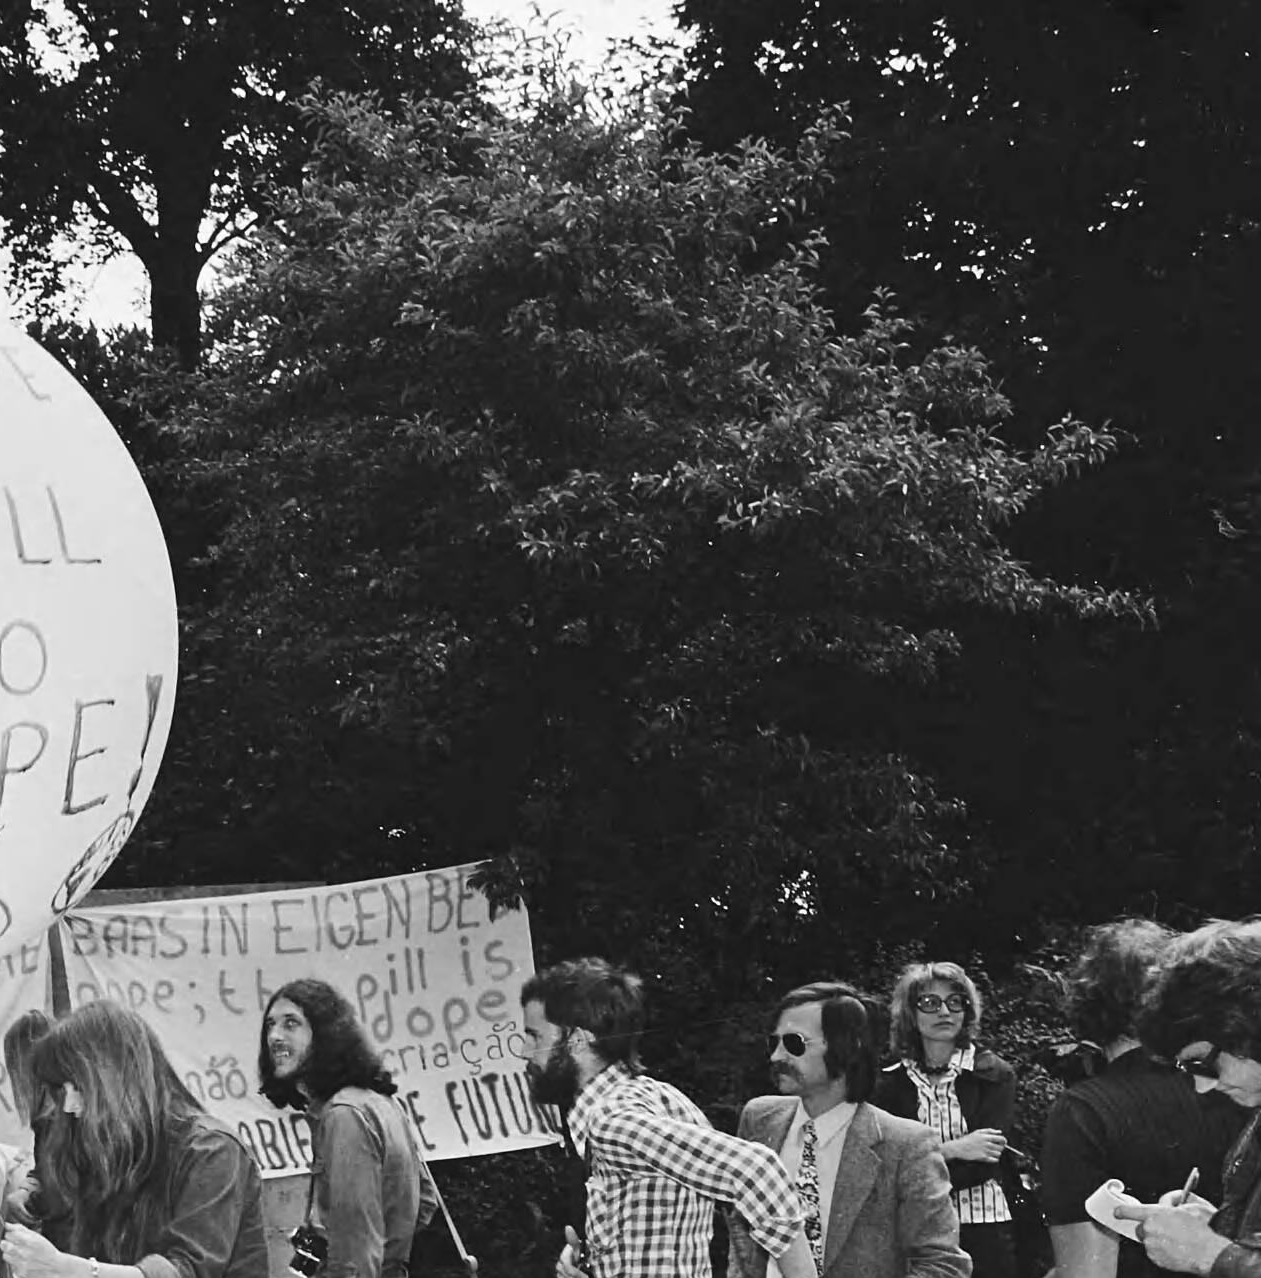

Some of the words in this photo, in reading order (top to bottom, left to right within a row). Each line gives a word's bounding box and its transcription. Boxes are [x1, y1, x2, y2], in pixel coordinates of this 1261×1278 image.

[66, 914, 189, 959] BAAS
[200, 901, 249, 957] IN
[272, 878, 411, 955] EIGEN
[425, 866, 482, 934] BE
[356, 947, 427, 1024] pill
[459, 936, 514, 987] is
[372, 988, 509, 1054] dope
